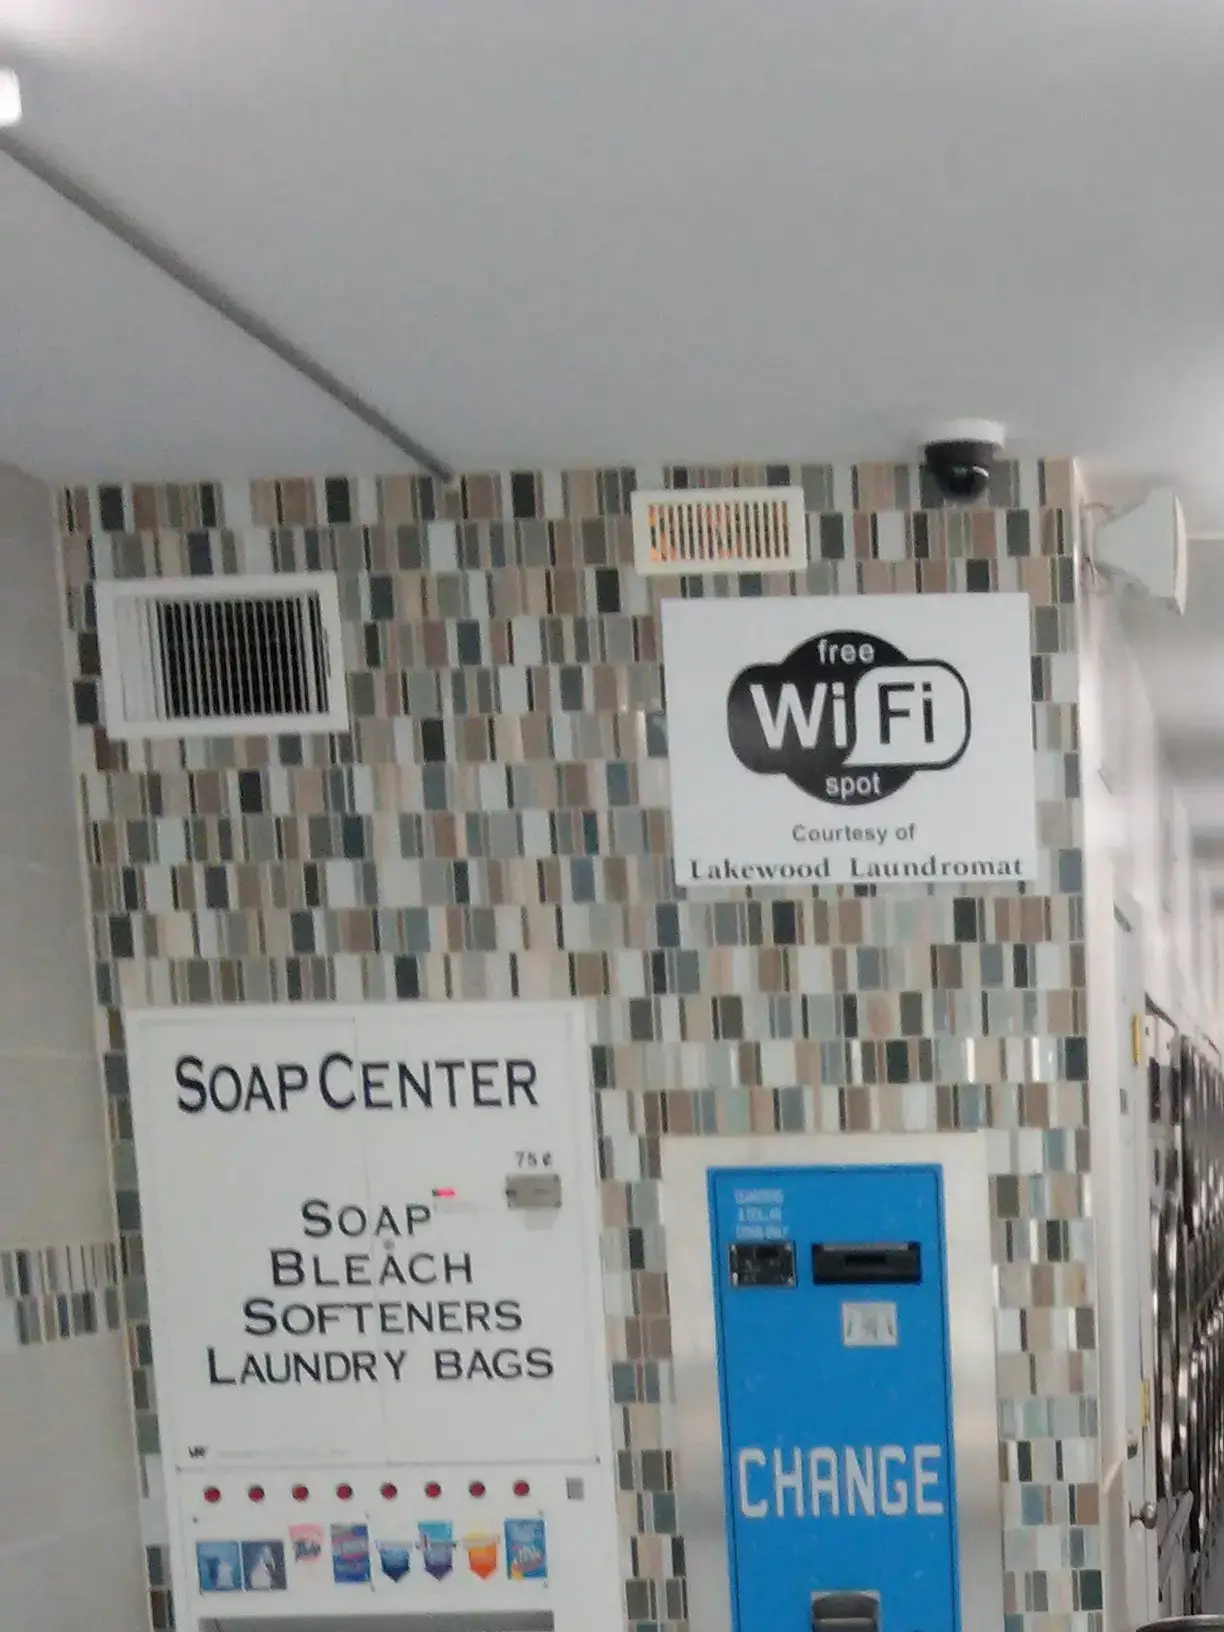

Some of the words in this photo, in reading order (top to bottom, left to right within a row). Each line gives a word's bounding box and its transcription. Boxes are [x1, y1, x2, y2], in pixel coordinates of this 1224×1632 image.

[818, 639, 875, 664] free
[825, 774, 881, 801] spot
[792, 824, 888, 845] Courtesy
[895, 823, 916, 842] of
[690, 857, 831, 880] Lakewood
[849, 854, 1023, 879] Laundromat
[300, 1198, 432, 1238] SOAP
[270, 1249, 473, 1288] BLEACH
[243, 1297, 523, 1337] SOFTENERS
[207, 1346, 407, 1385] LAUNDRY
[434, 1346, 555, 1382] BAGS
[738, 1445, 944, 1517] CHANGE
